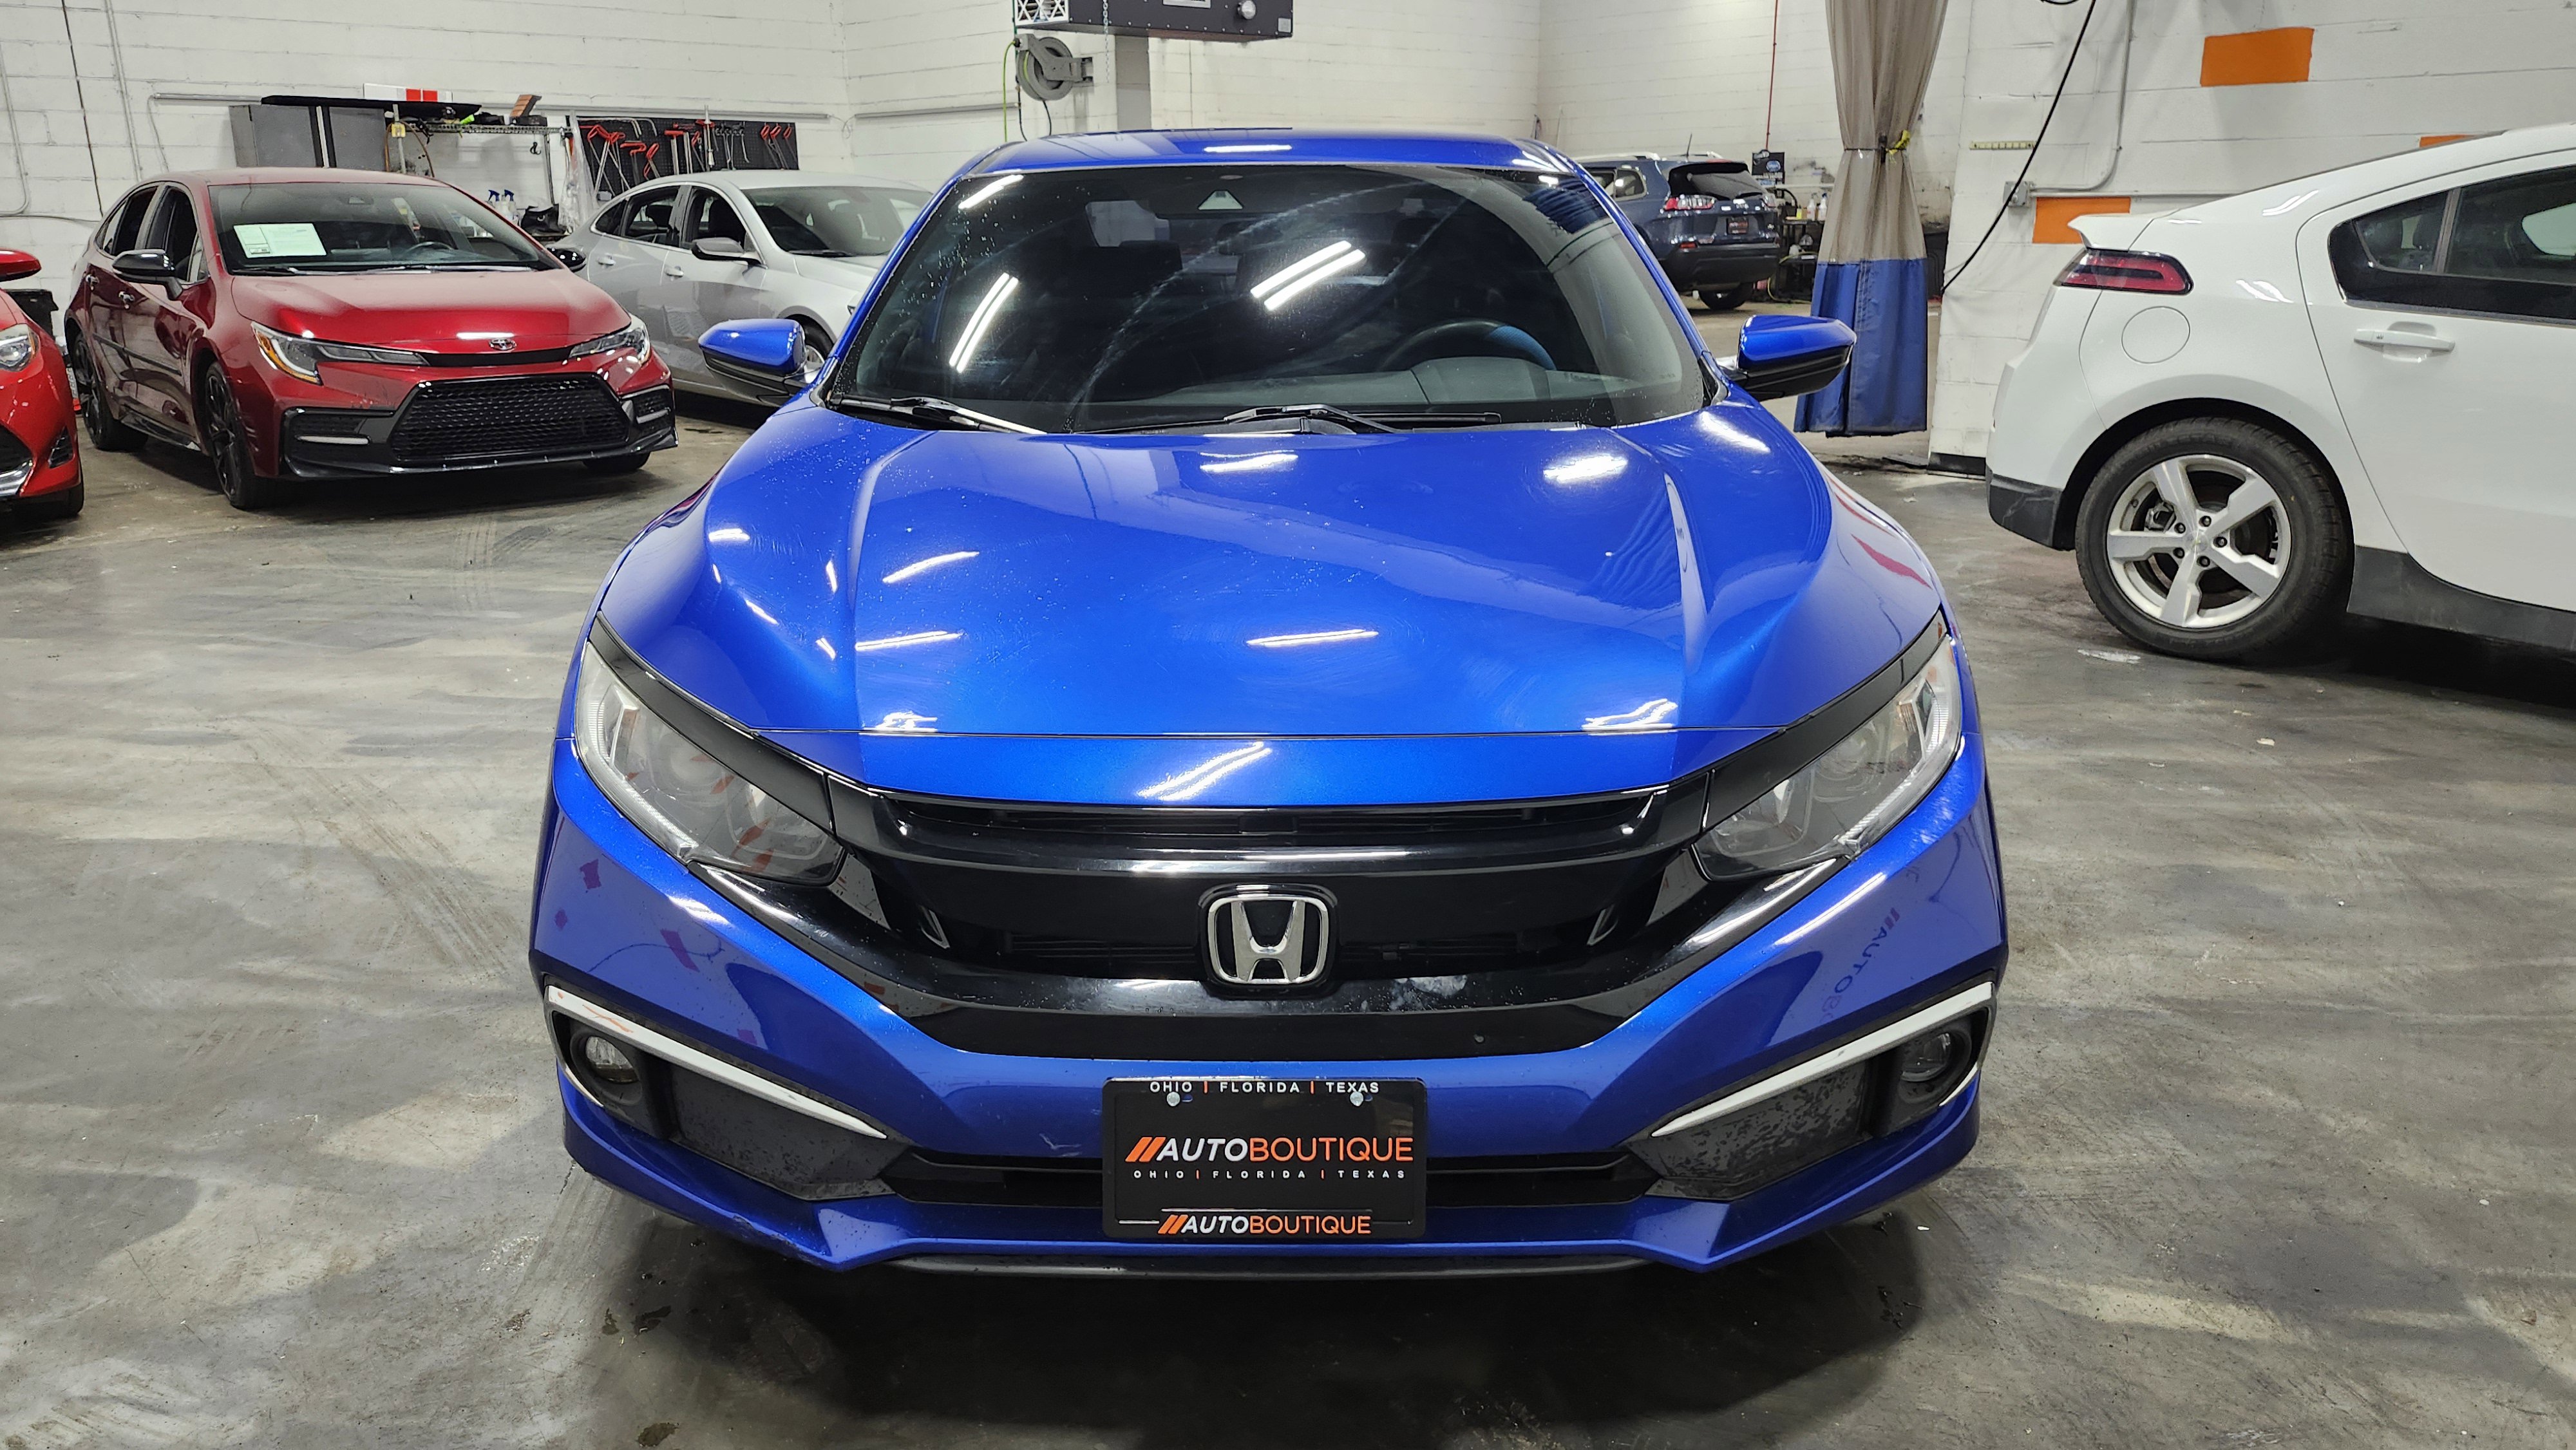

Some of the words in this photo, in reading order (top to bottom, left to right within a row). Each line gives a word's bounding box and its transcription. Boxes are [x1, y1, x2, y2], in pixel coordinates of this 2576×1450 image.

[1150, 1082, 1192, 1093] OHIO
[1220, 1082, 1300, 1093] FLORIDA
[1326, 1082, 1379, 1093] TEXAS
[1157, 1137, 1414, 1162] AUTOBOUTIQUE
[1133, 1170, 1184, 1179] OHIO
[1213, 1171, 1305, 1179] FLORIDA
[1338, 1170, 1405, 1179] TEXAS
[1181, 1216, 1371, 1234] AUTOBOUTIQUE
